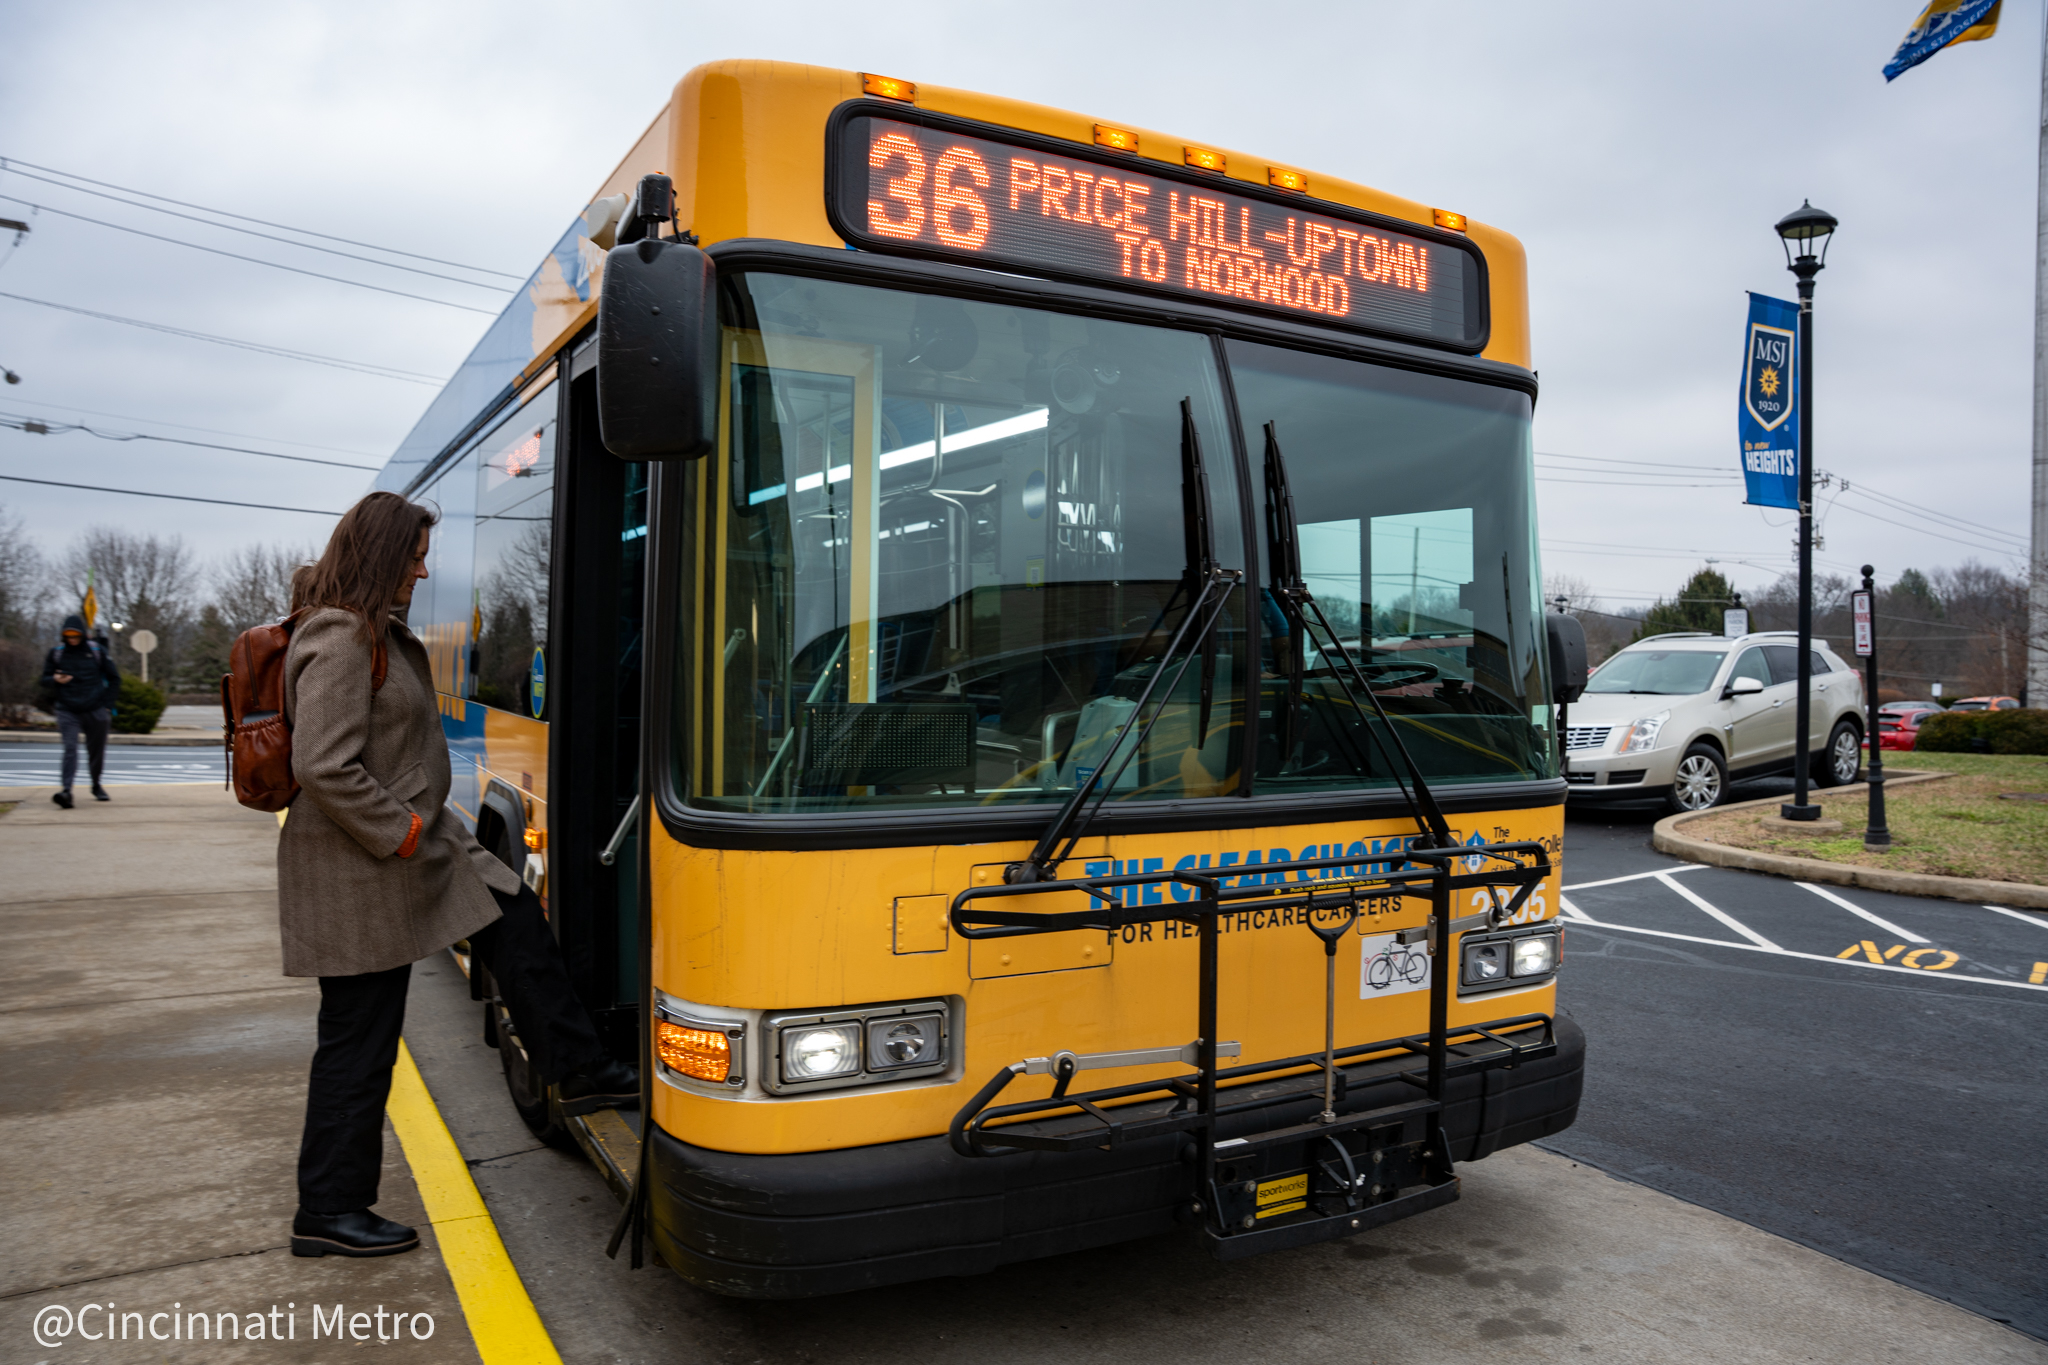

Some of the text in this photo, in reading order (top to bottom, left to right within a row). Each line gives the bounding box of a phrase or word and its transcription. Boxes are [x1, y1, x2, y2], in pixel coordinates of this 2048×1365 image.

[867, 131, 991, 251] 36
[1009, 156, 1428, 293] PRICE HILL-UPTOWN
[1114, 231, 1350, 317] TO NORWOOD
[1756, 337, 1787, 369] MSJ
[1758, 400, 1780, 412] 1920
[1745, 449, 1795, 477] HEIGHTS
[1493, 826, 1510, 838] The
[1085, 857, 1163, 910] THE
[1107, 922, 1153, 946] FOR
[1836, 940, 1960, 970] NO
[1258, 1180, 1306, 1199] sportworks
